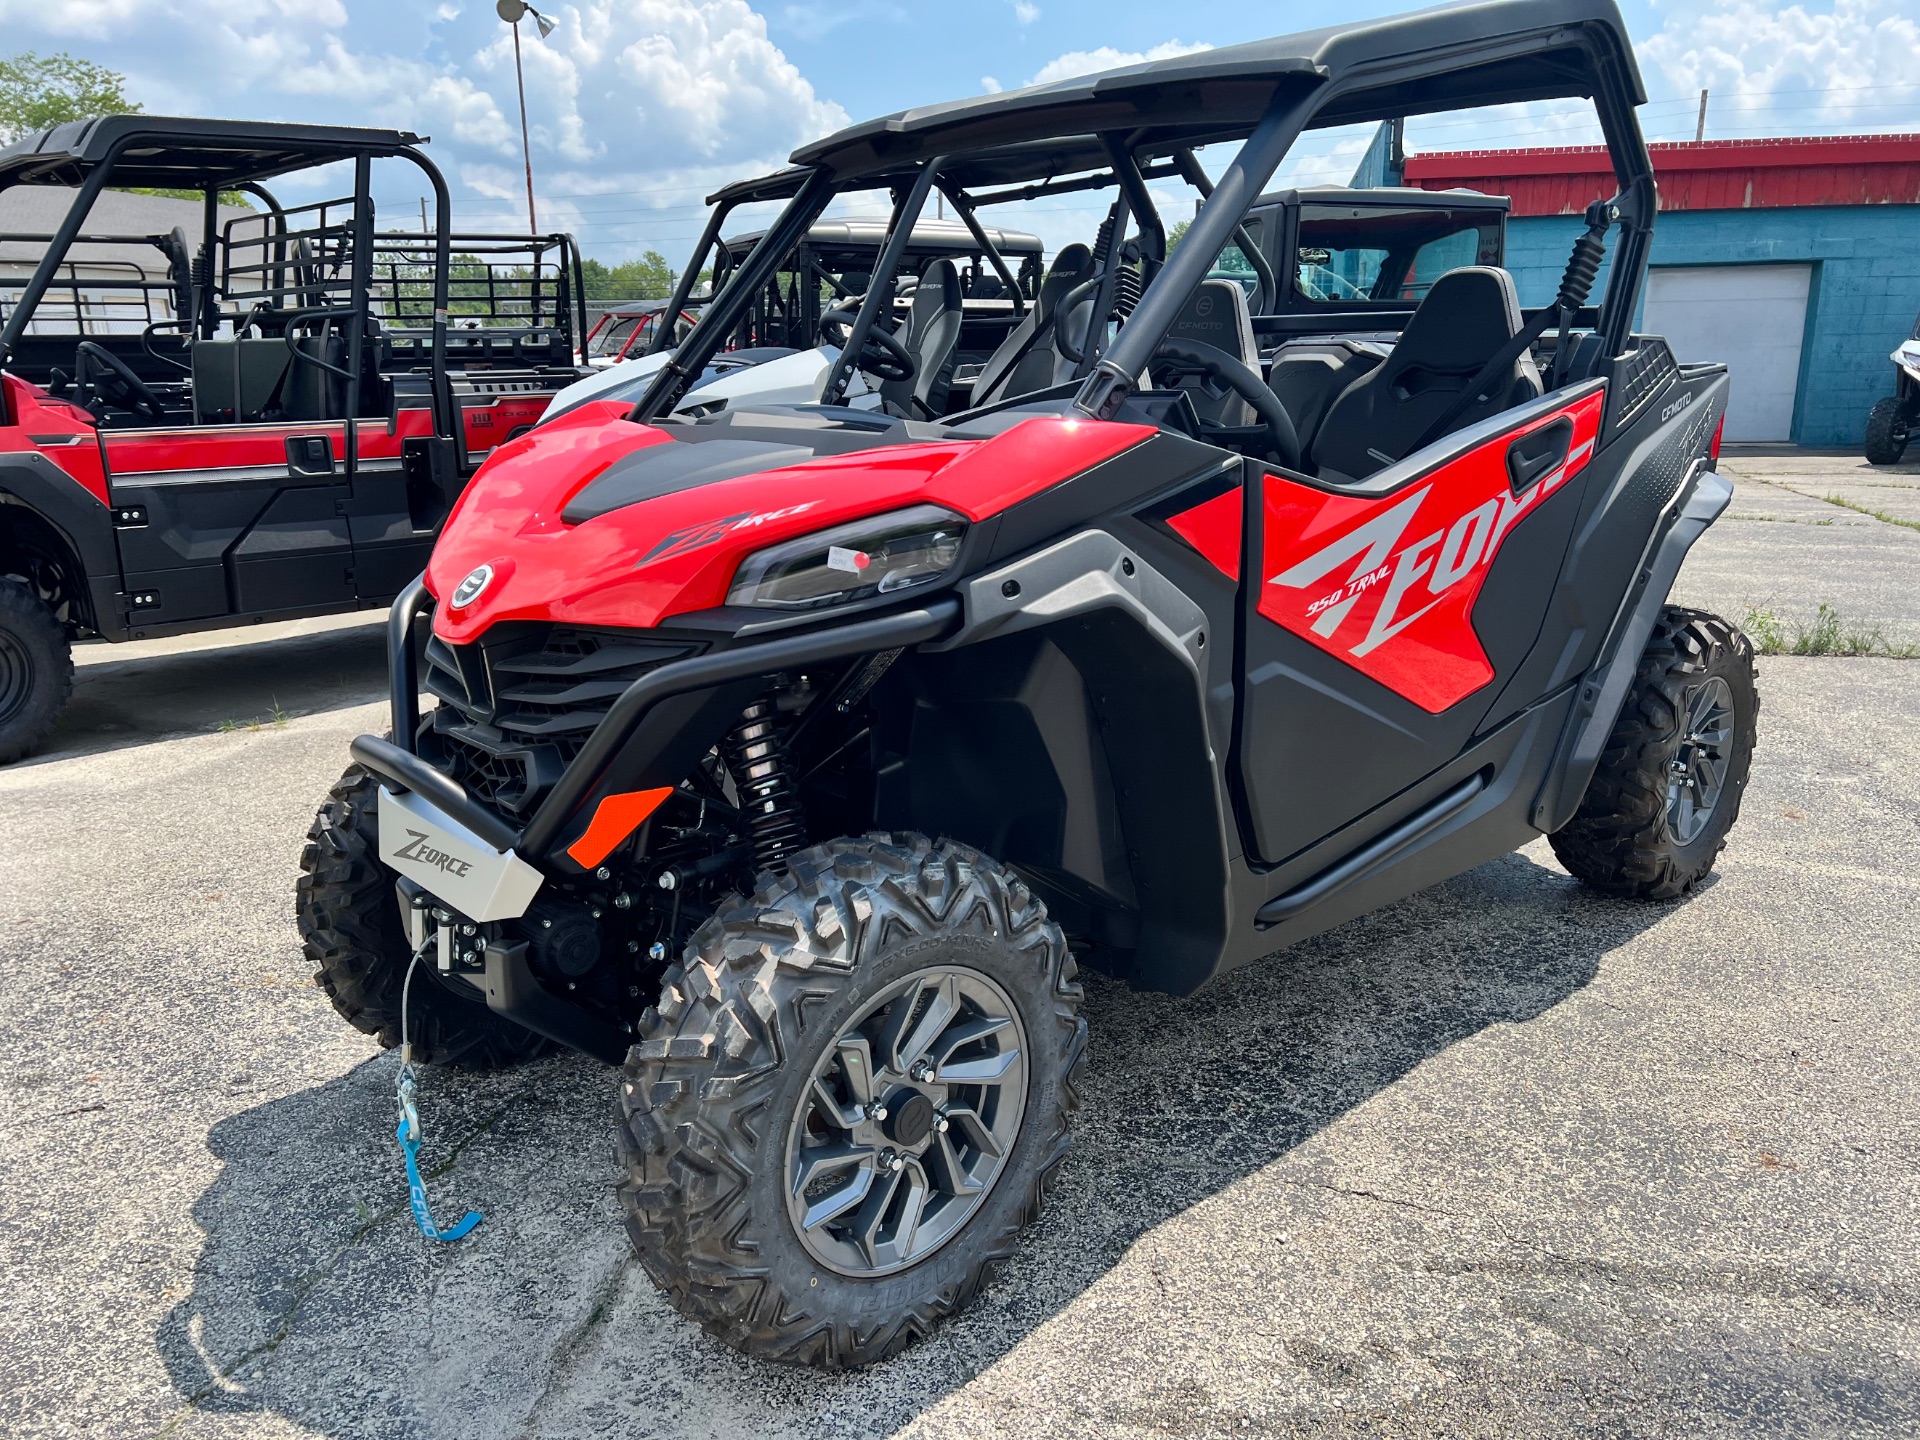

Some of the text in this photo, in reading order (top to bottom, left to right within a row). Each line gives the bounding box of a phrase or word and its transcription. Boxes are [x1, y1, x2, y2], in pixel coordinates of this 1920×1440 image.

[1177, 321, 1224, 331] CFMOTO
[1661, 391, 1692, 422] CFMOTO
[1305, 564, 1391, 617] 950 TRAIL
[392, 828, 474, 878] ZFORCE
